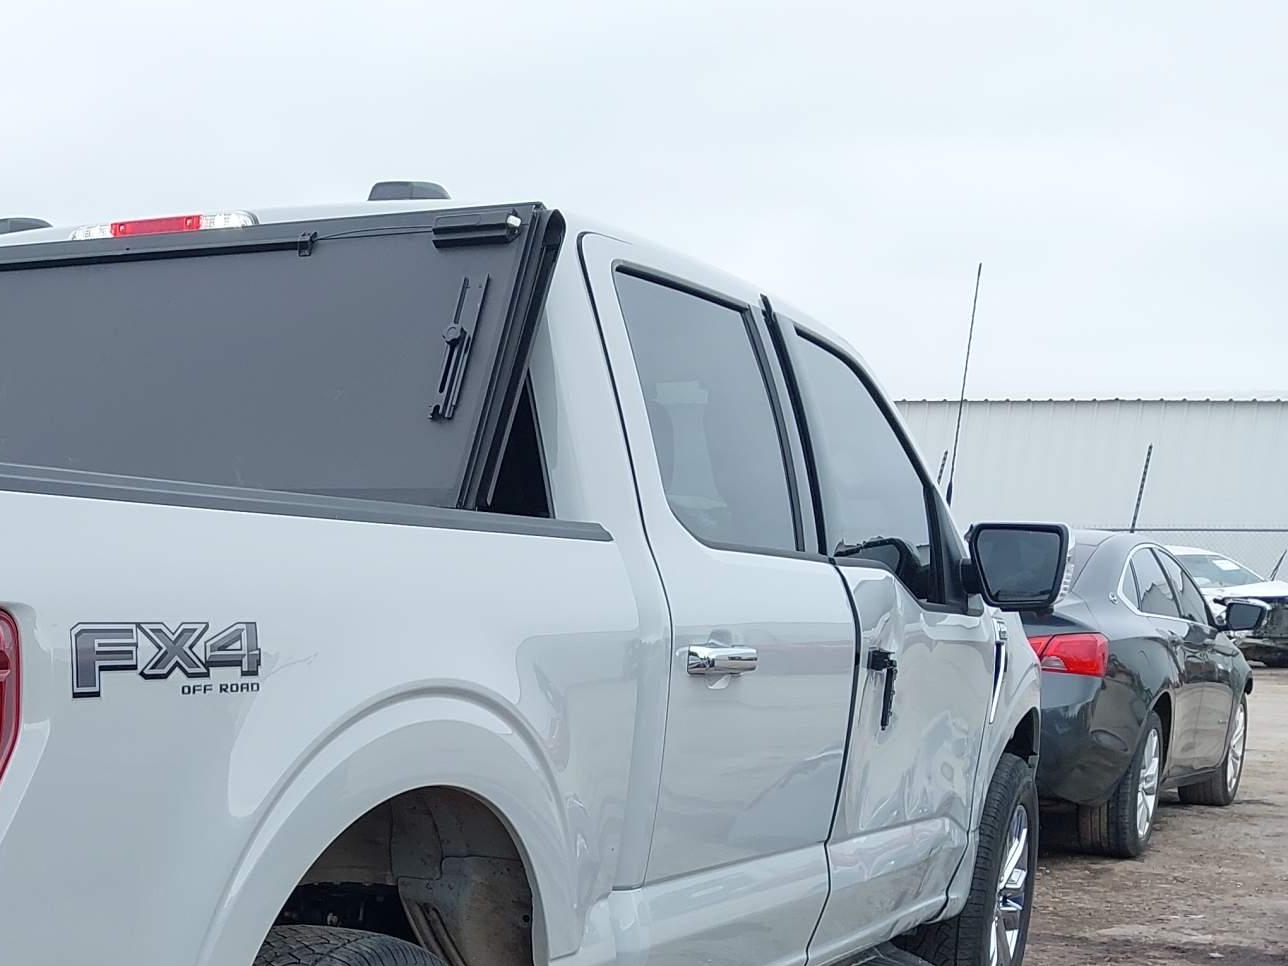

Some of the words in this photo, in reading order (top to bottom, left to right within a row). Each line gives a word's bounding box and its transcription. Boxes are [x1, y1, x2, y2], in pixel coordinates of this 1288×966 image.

[70, 622, 261, 698] FX4
[181, 684, 213, 695] OFF
[219, 682, 260, 694] ROAD
